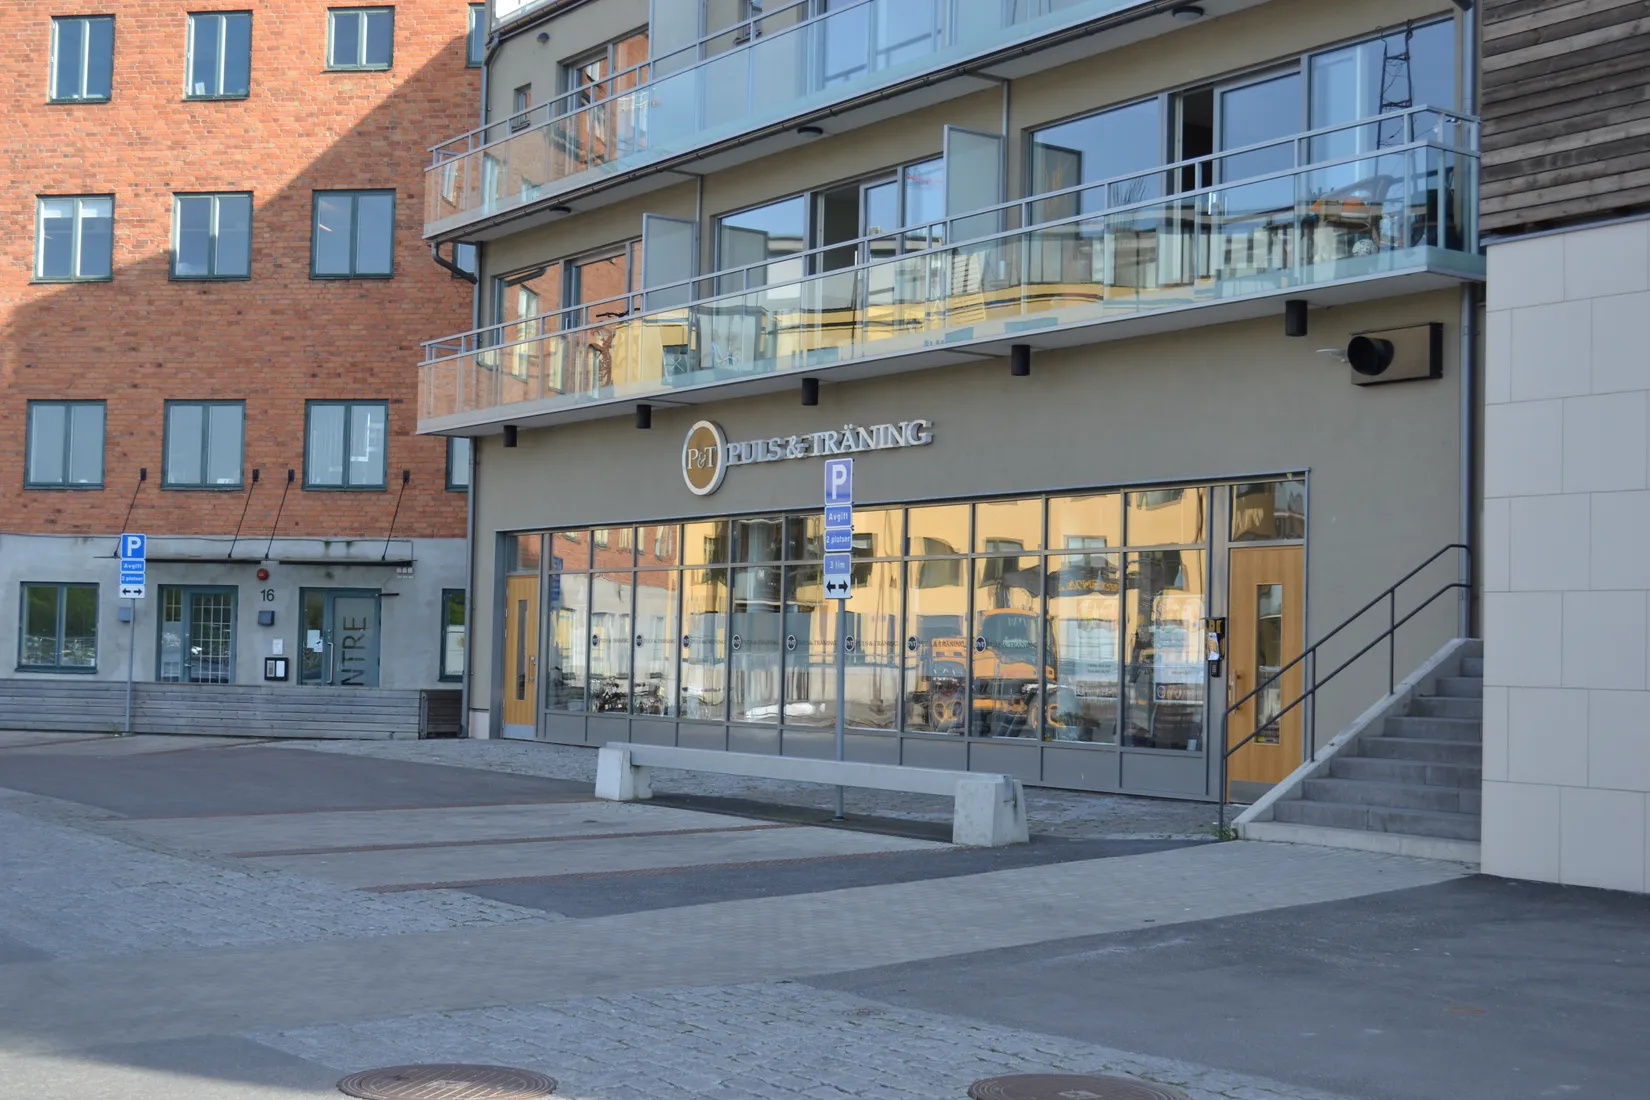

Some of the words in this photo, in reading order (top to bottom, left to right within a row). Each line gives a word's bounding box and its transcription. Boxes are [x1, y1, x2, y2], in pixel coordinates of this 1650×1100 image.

[727, 437, 782, 465] PULS
[784, 435, 809, 458] &
[810, 419, 933, 456] TRÄNING
[687, 446, 717, 470] P&T
[832, 464, 847, 500] P
[829, 513, 848, 523] Avgift
[127, 536, 142, 557] P
[831, 535, 850, 544] platser
[829, 561, 834, 569] 3
[835, 561, 845, 569] tim
[260, 588, 275, 602] 16
